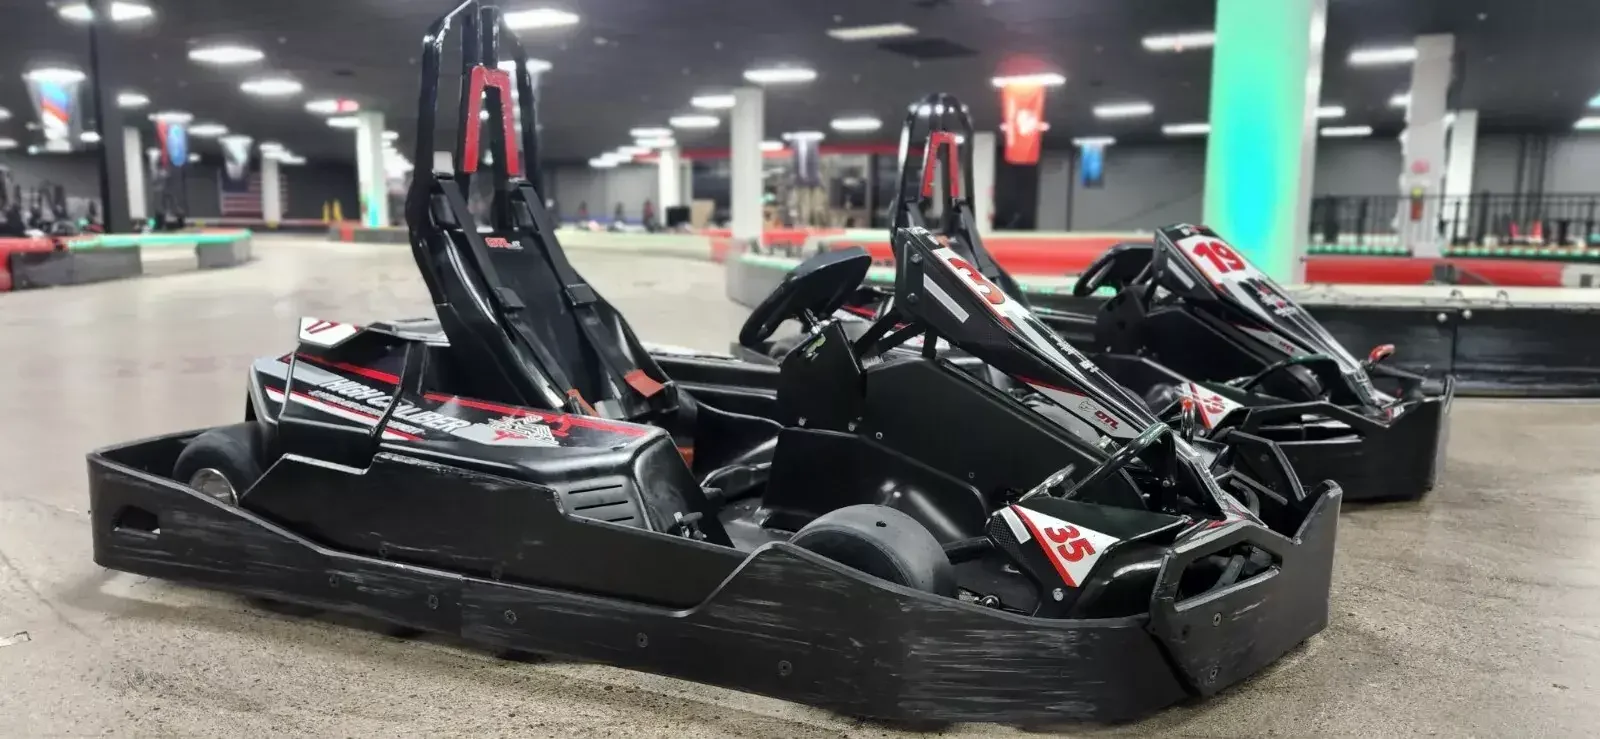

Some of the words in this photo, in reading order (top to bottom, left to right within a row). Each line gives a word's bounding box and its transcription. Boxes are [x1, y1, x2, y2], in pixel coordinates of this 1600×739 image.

[1192, 240, 1246, 273] 19
[318, 373, 386, 400] HIGH
[1043, 525, 1097, 563] 35
